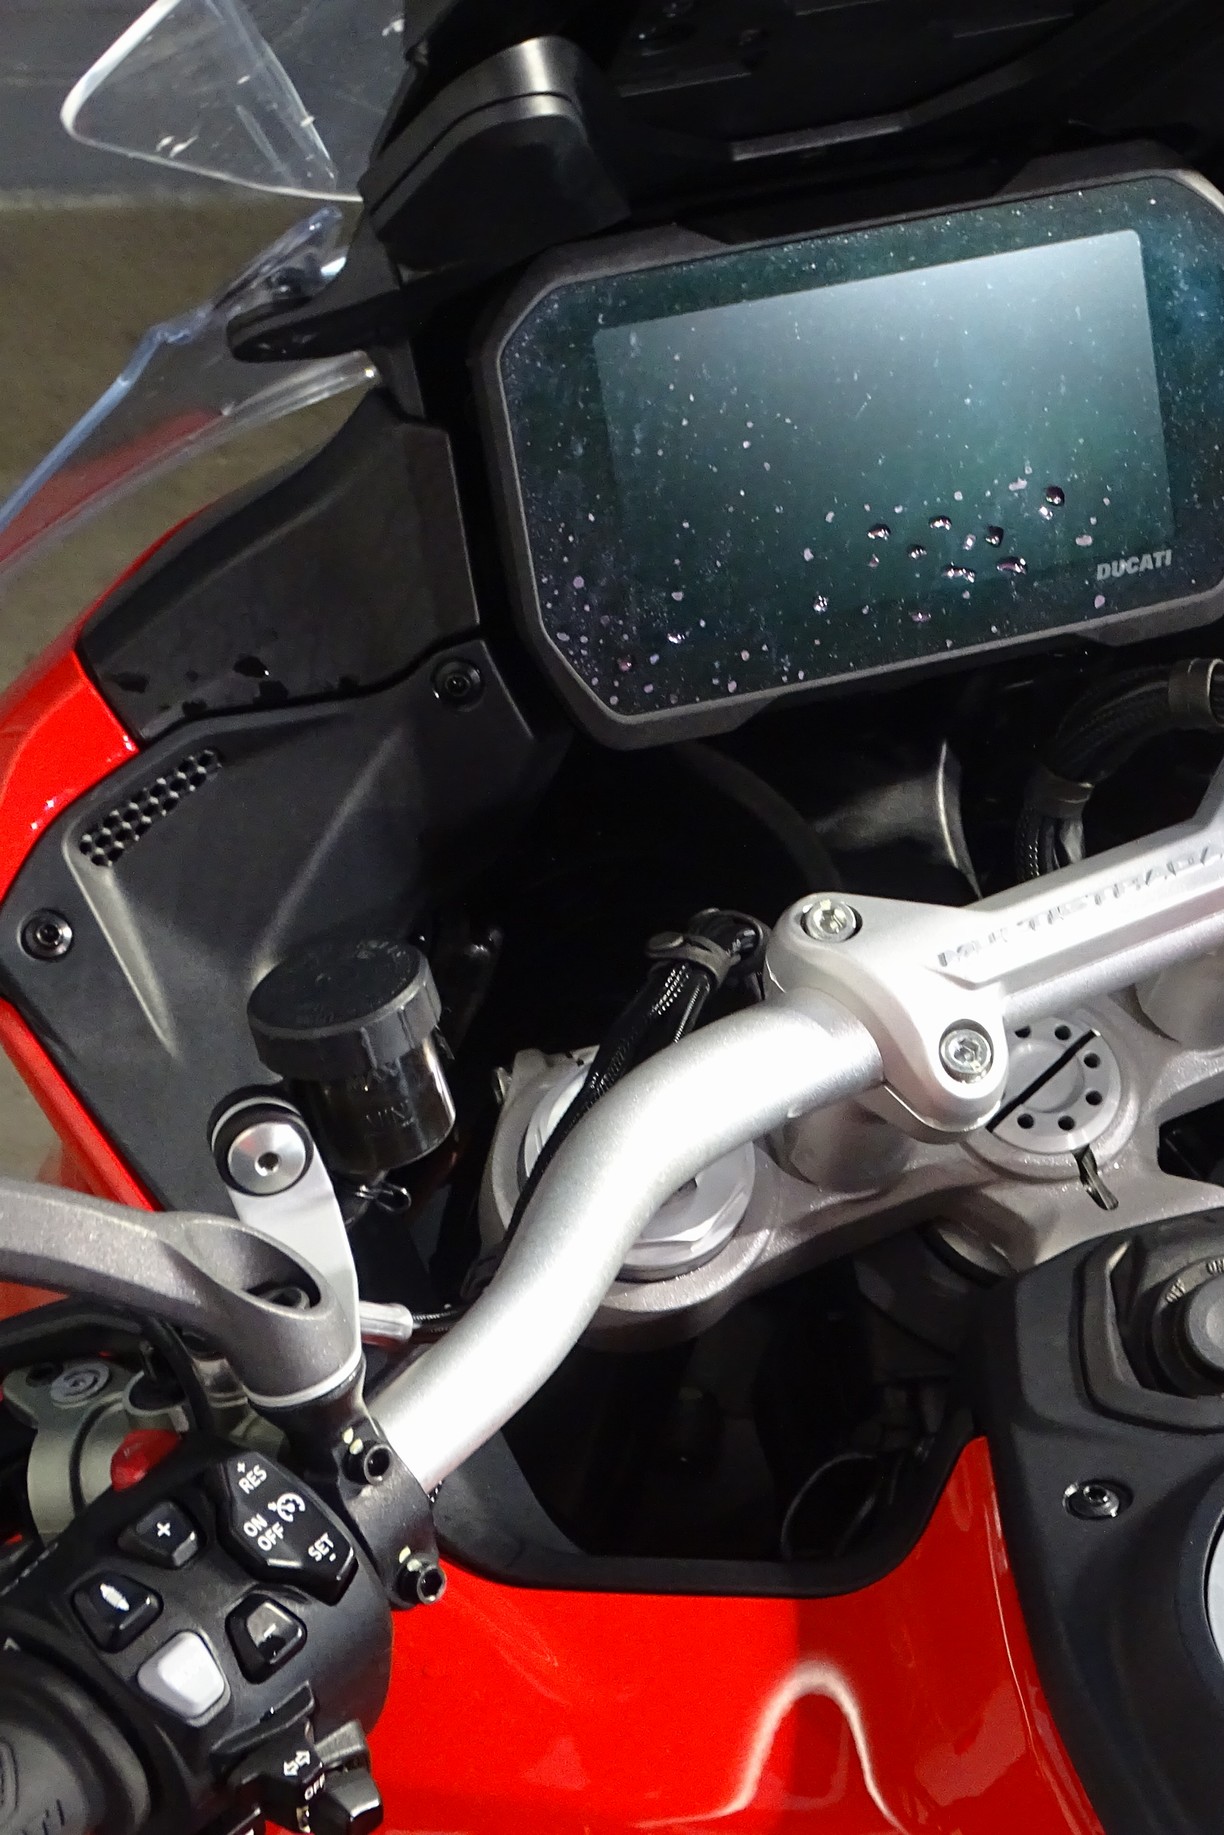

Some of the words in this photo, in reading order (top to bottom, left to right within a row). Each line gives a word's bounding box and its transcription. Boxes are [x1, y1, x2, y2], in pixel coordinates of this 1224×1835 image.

[1096, 549, 1172, 580] DUCATI
[239, 1465, 267, 1494] RES
[243, 1513, 268, 1537] ON
[257, 1522, 284, 1552] OFF
[308, 1532, 334, 1562] SET
